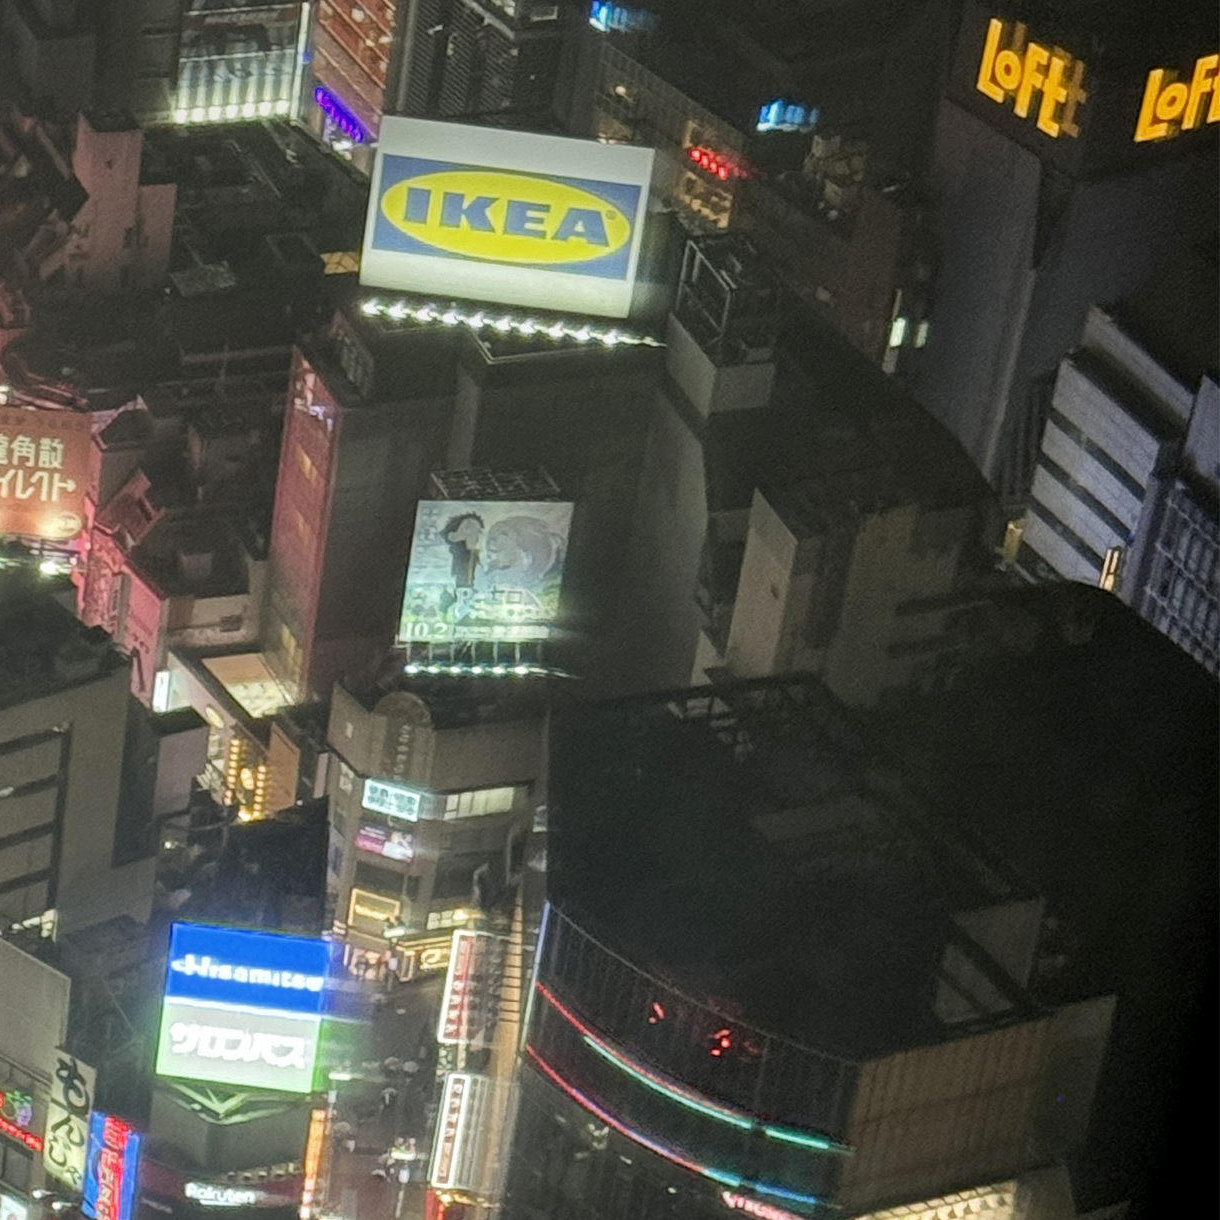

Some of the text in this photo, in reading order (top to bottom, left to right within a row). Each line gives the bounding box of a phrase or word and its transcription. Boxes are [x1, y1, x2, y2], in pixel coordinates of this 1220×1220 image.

[404, 187, 611, 248] IKEA
[406, 622, 448, 638] 10.2
[170, 1022, 306, 1069] サロンパス
[185, 1181, 256, 1204] Rakuten
